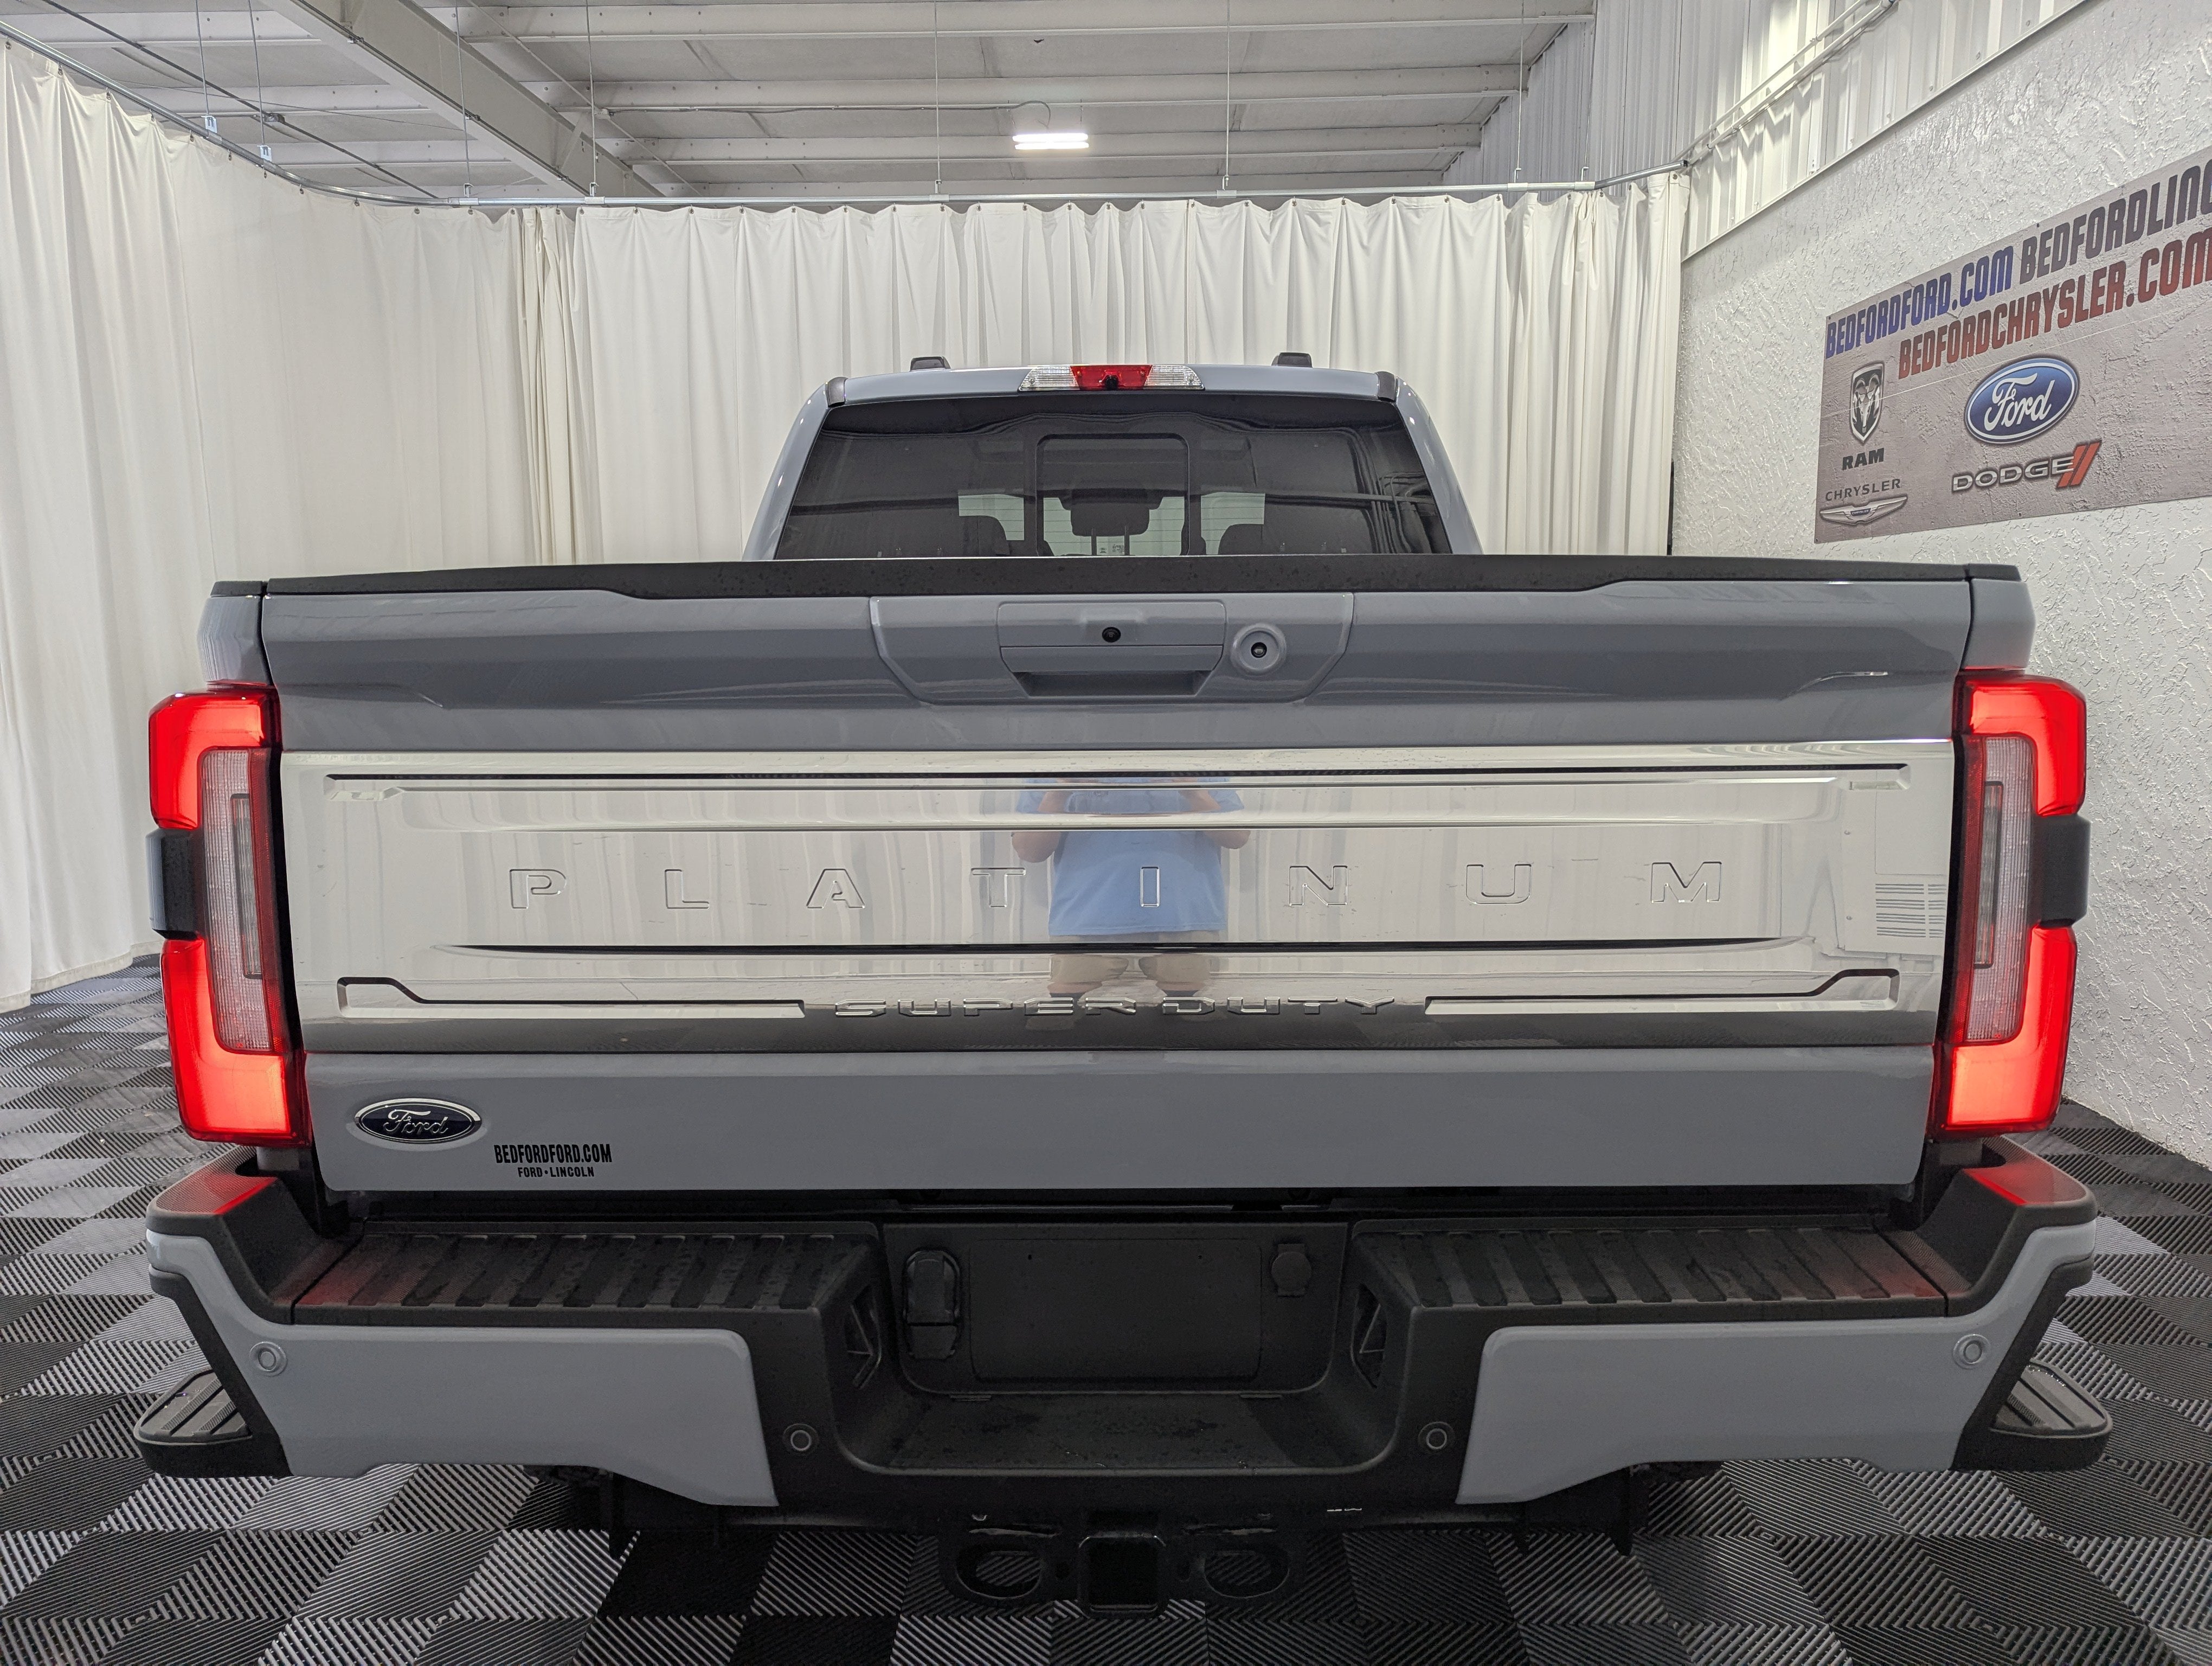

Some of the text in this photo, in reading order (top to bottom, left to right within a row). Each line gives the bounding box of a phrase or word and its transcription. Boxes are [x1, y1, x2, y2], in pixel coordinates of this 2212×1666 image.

[1825, 246, 2014, 360] BEDFORDFORD.COM
[1899, 227, 2212, 380] BEDFORDCHRYSLER.COM
[1984, 373, 2056, 431] Ford
[1842, 447, 1885, 470] RAM
[1953, 456, 2075, 491] DODGE
[1825, 478, 1901, 502] CHRYSLER
[509, 861, 1722, 910] PLATINUM
[383, 1109, 449, 1135] Ford
[494, 1144, 613, 1163] BEDFORDFORD.COM
